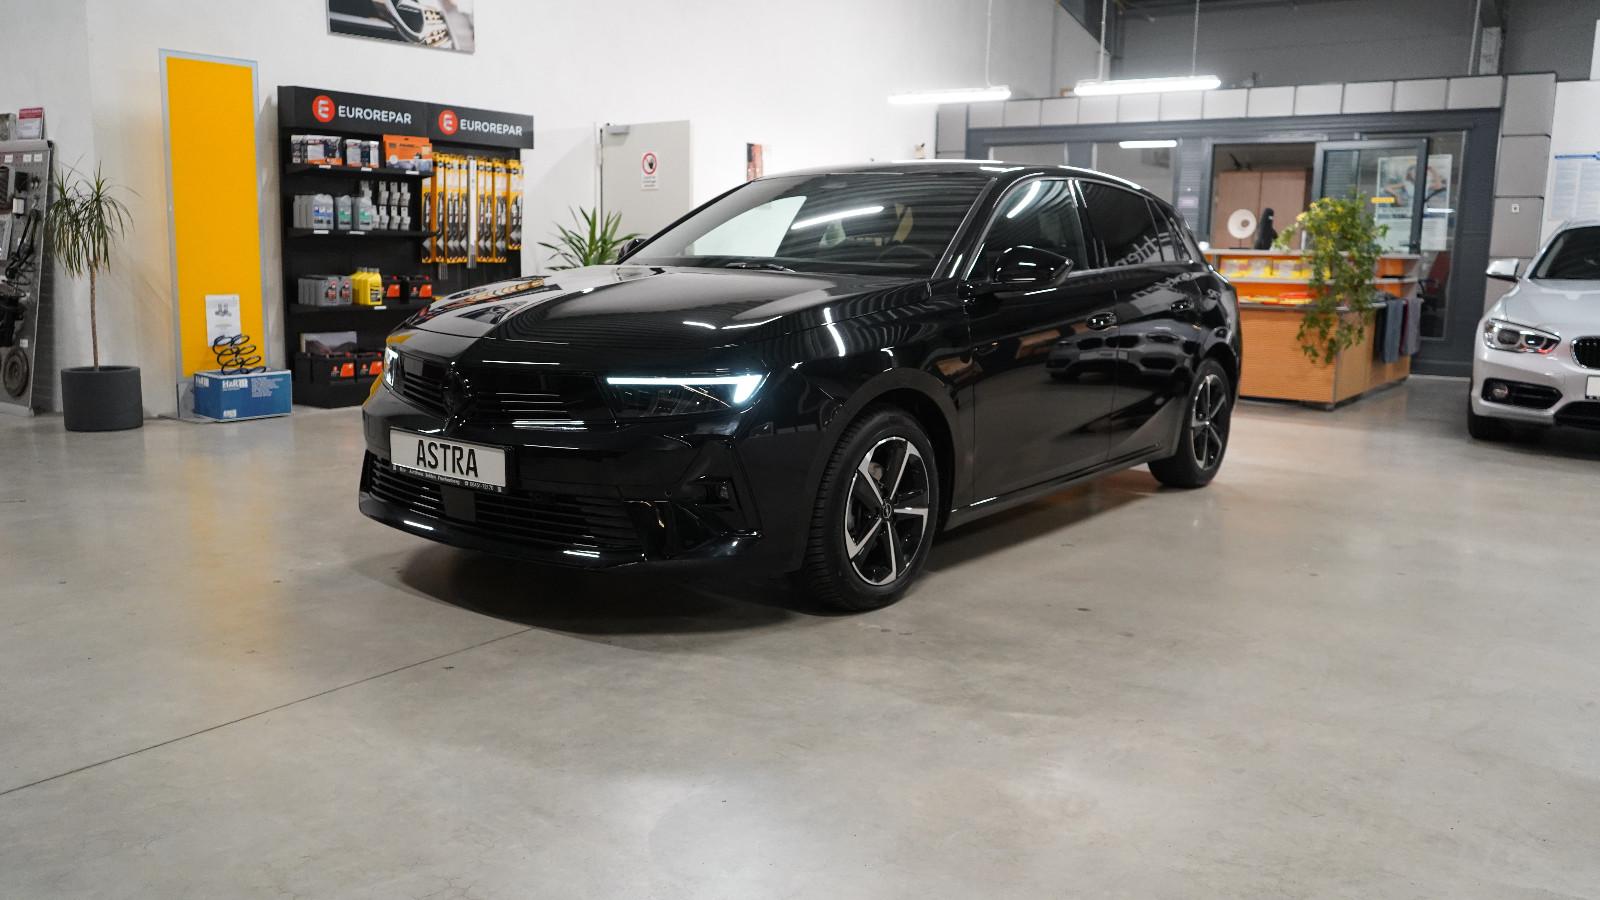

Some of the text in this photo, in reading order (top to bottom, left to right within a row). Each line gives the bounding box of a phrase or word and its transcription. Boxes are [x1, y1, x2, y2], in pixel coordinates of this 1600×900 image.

[338, 105, 412, 125] EUROREPAR
[460, 119, 523, 136] EUROREPAR
[416, 439, 478, 478] ASTRA
